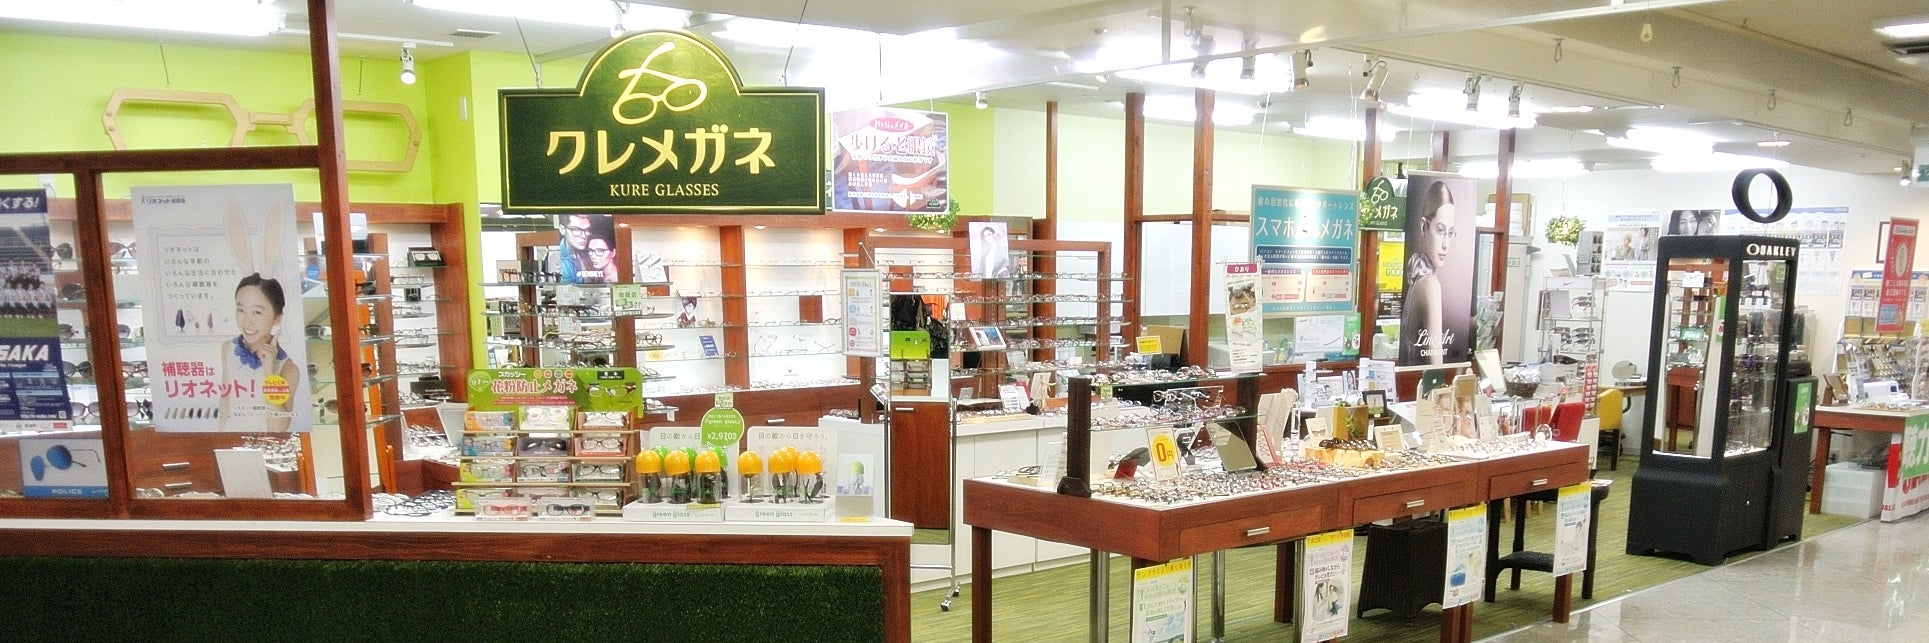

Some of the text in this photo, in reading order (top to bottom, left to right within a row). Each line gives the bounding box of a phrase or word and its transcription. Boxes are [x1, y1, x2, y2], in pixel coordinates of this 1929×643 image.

[546, 128, 775, 175] クレメガネ
[609, 184, 720, 197] KURE GLASSES
[161, 362, 215, 380] 補聴器は
[164, 381, 256, 398] リオネット!
[491, 379, 578, 393] 花粉防止メガネ
